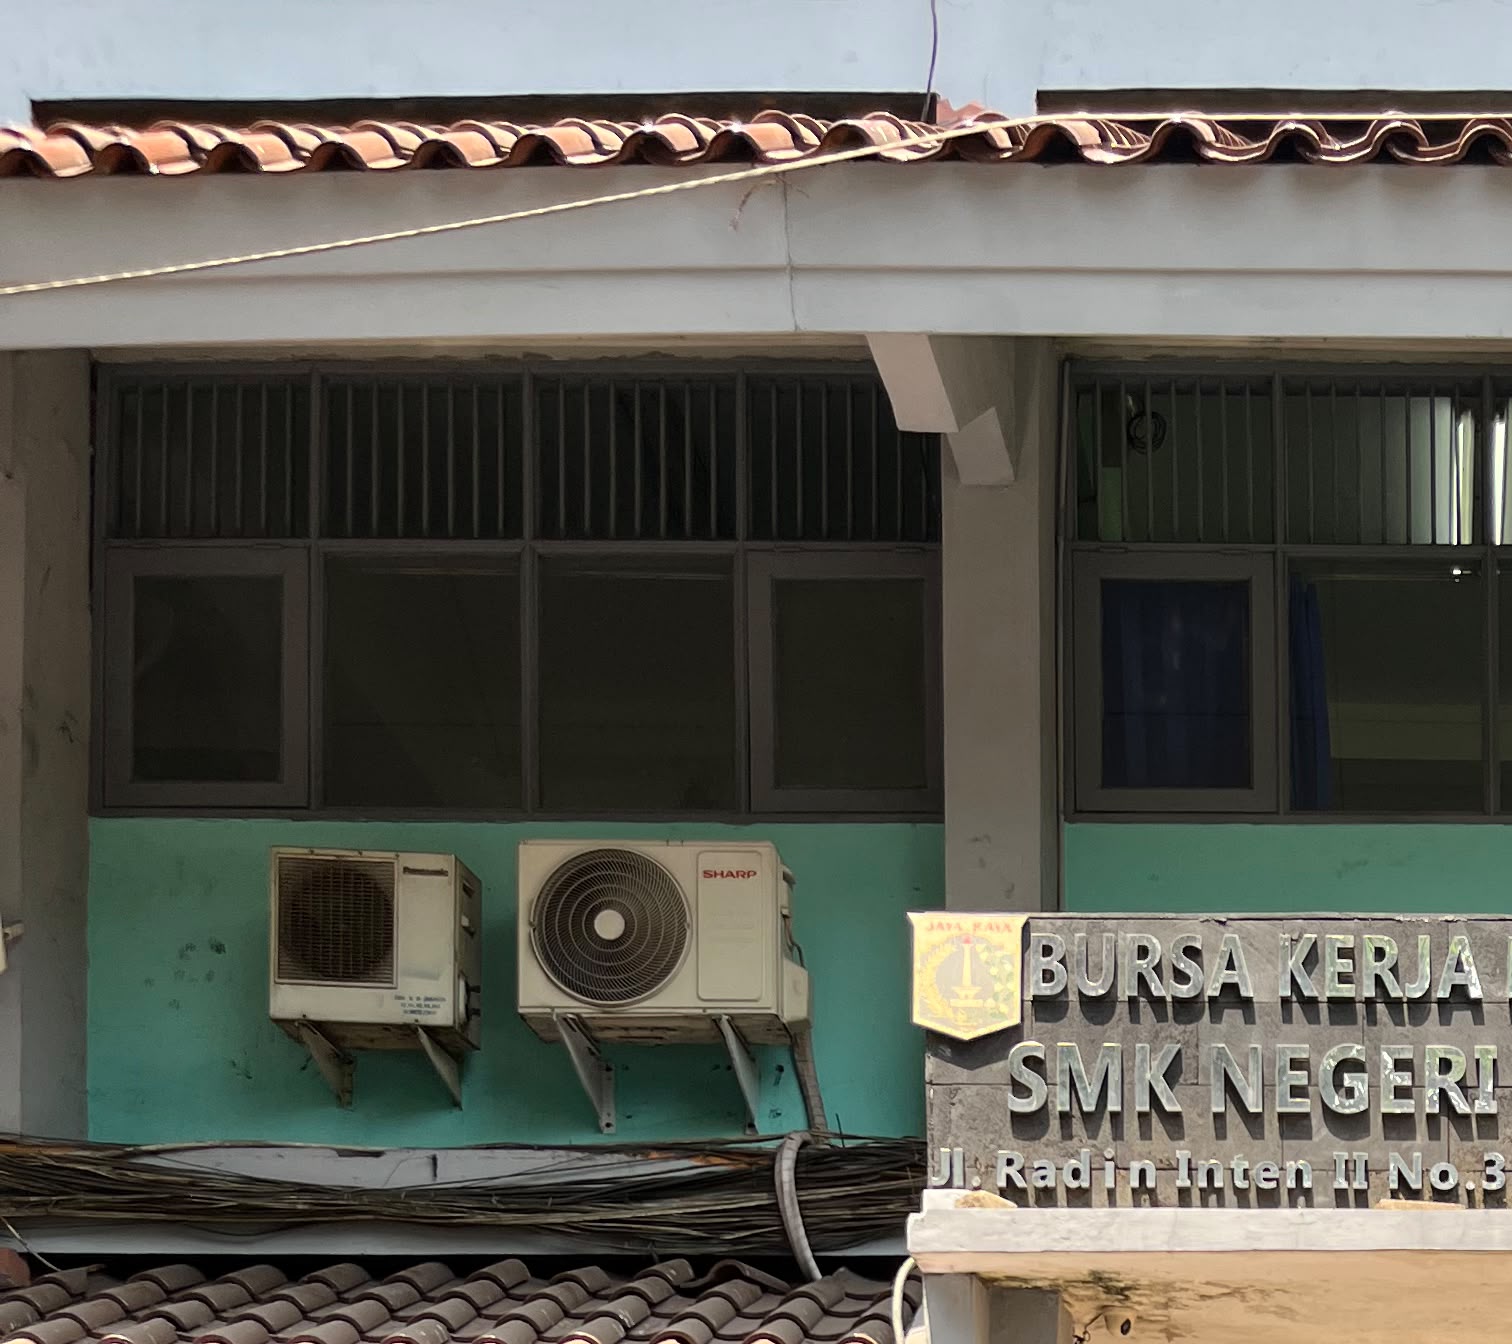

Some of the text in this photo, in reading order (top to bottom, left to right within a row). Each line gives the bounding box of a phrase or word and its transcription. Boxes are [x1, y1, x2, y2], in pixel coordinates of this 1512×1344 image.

[702, 869, 758, 879] SHARP
[1030, 931, 1254, 1000] BURSA
[1279, 932, 1484, 1001] KERJA
[1006, 1040, 1183, 1115] SMK
[1210, 1042, 1499, 1116] NEGERI
[929, 1146, 982, 1190] Jl.
[996, 1147, 1158, 1191] Radin
[1175, 1149, 1313, 1191] Inten
[1332, 1151, 1369, 1190] II
